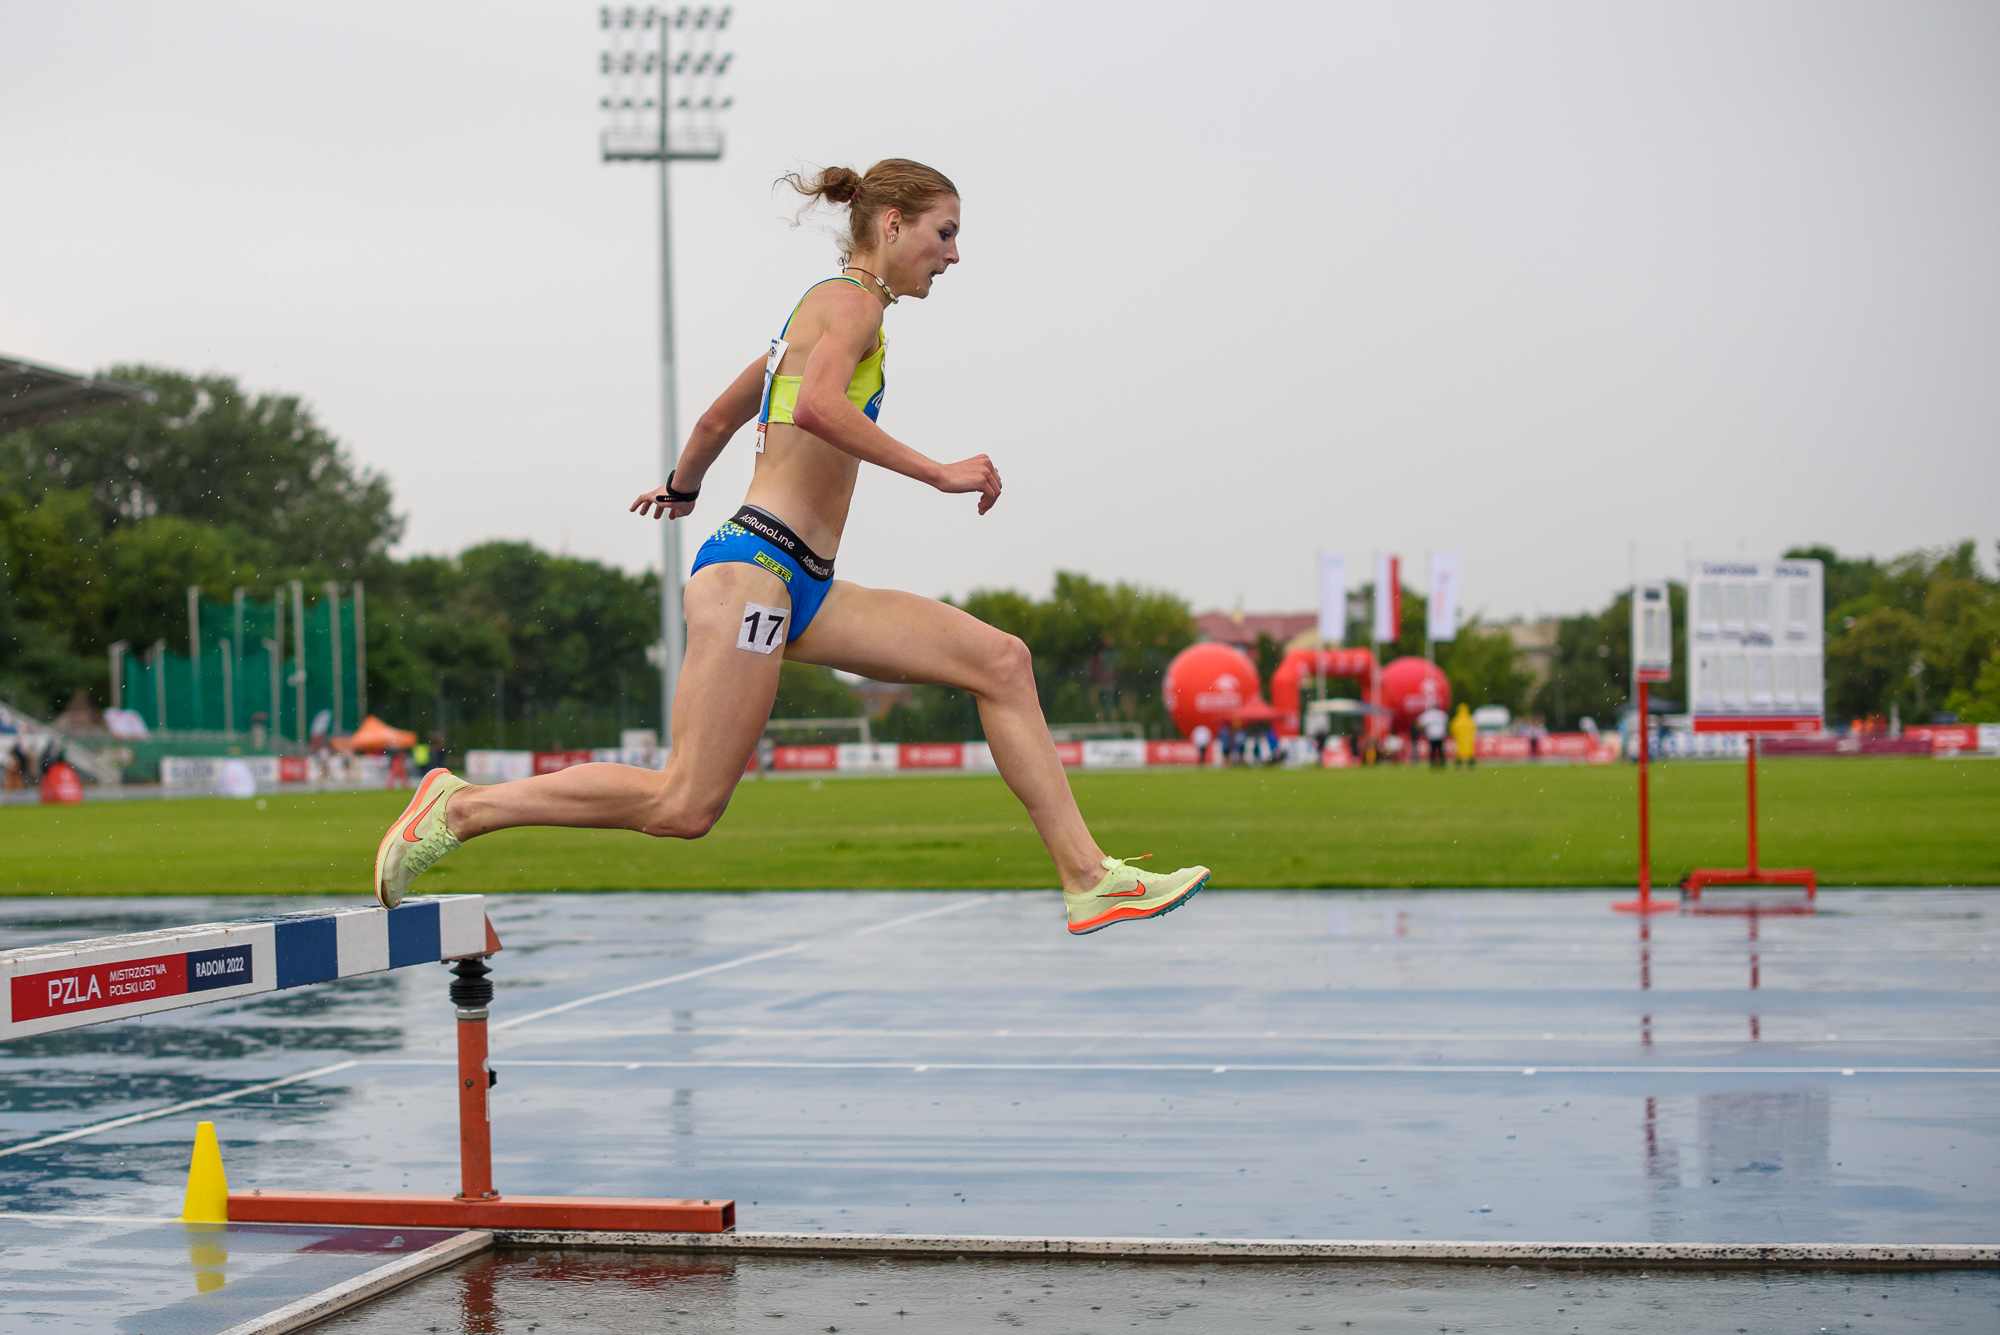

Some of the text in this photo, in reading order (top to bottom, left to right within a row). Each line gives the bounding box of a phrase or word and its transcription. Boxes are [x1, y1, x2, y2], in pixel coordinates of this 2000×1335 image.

[744, 611, 785, 646] 17
[109, 963, 167, 982] MISTRZOSTWA
[195, 956, 244, 978] RADOM 2022
[48, 973, 102, 1007] PZLA
[109, 979, 156, 997] POLSKI U20
